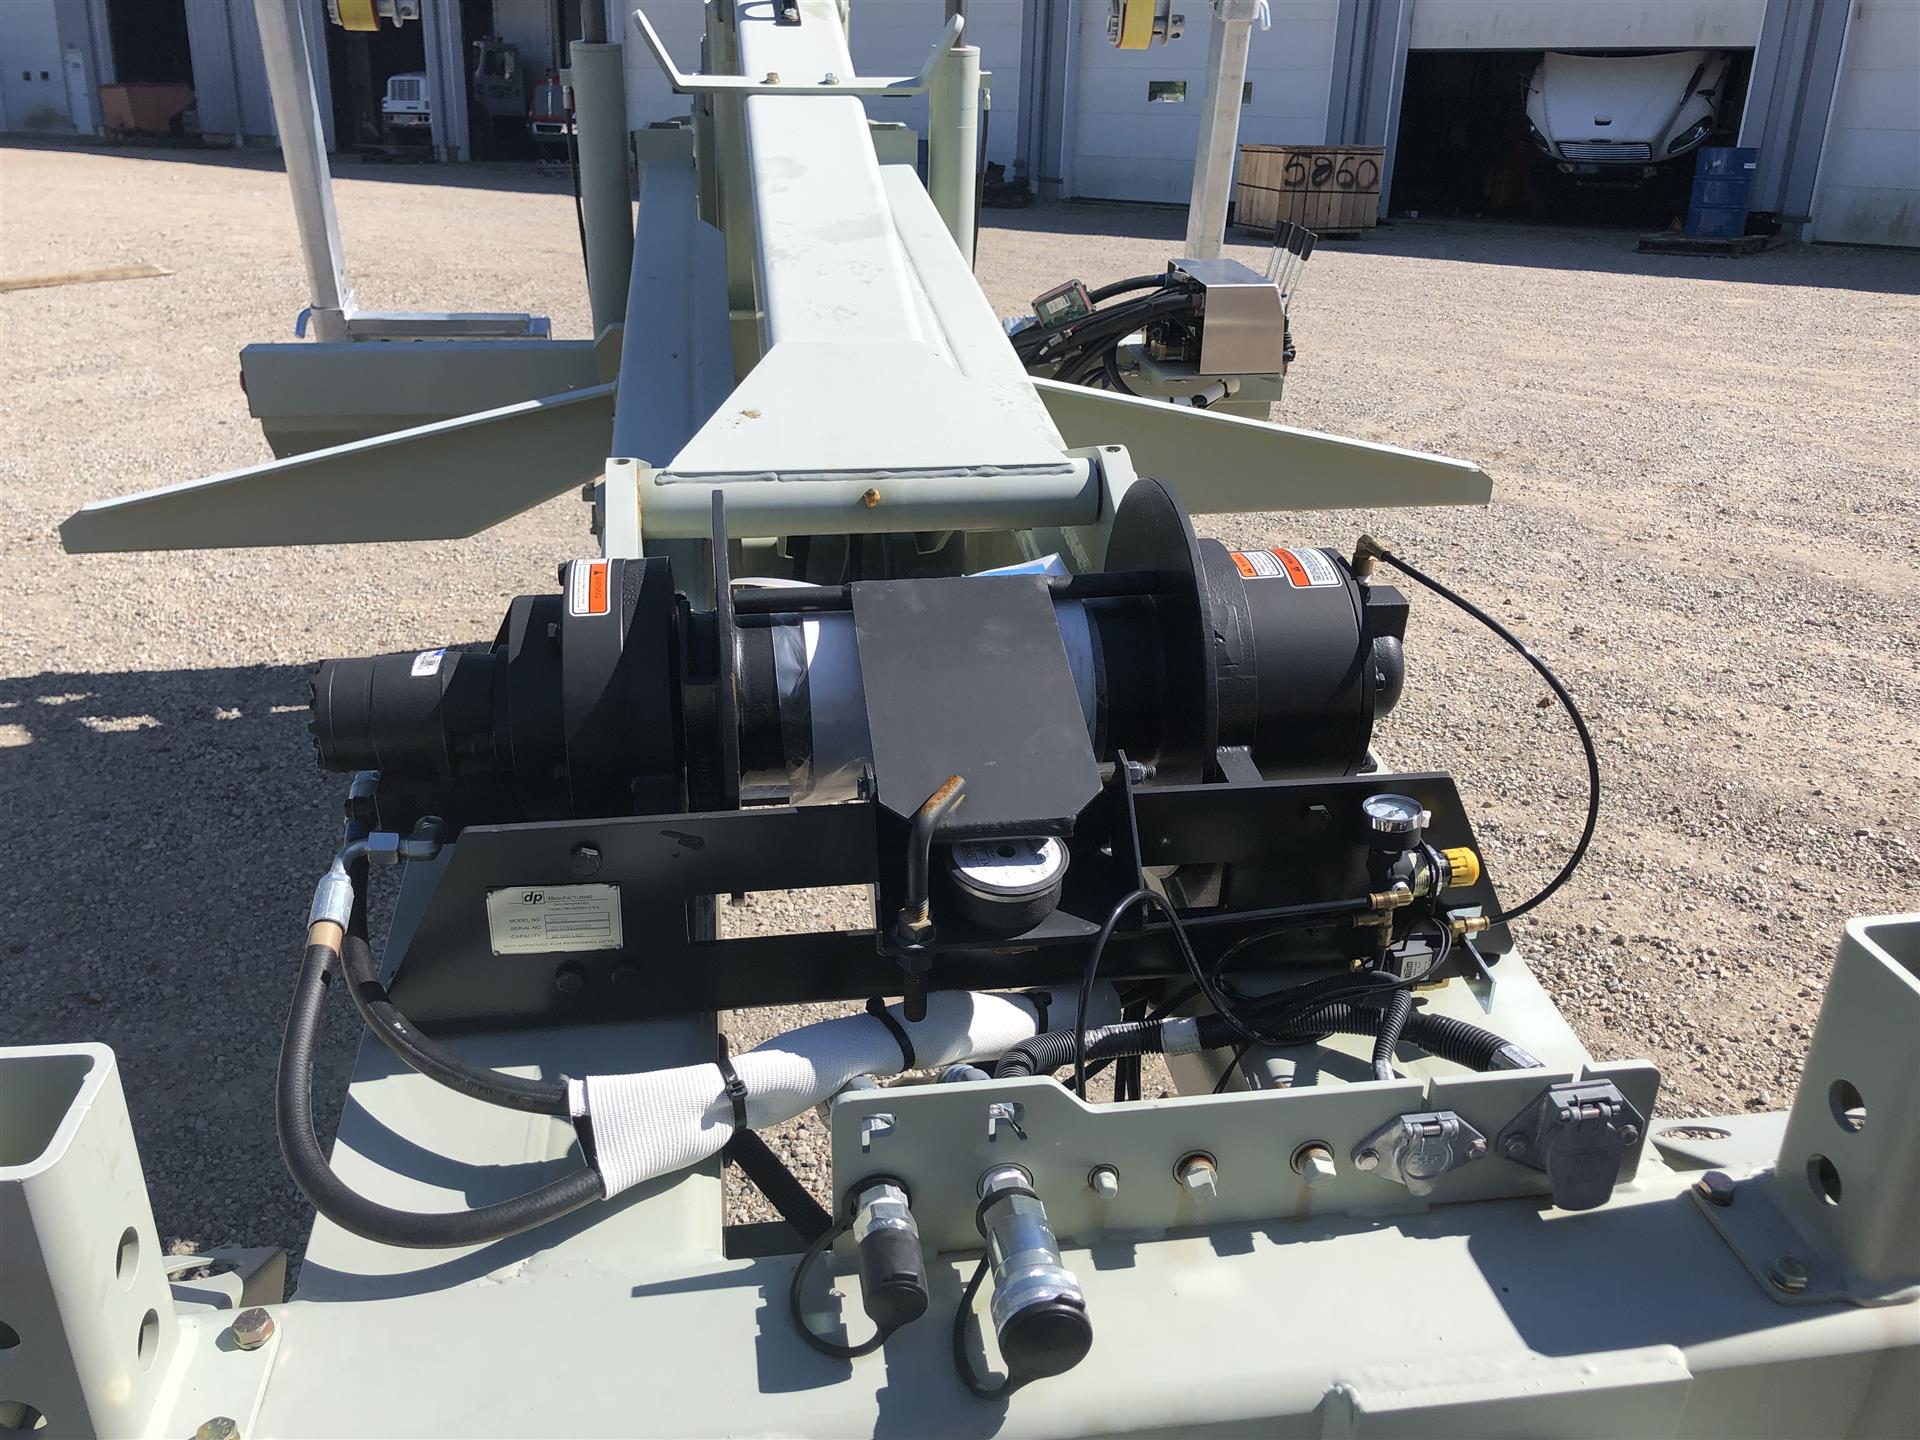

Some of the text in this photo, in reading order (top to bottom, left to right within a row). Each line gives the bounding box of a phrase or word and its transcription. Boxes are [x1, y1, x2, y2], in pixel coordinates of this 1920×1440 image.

[1284, 152, 1379, 191] 5860
[523, 891, 543, 904] dp
[988, 1102, 1027, 1142] R
